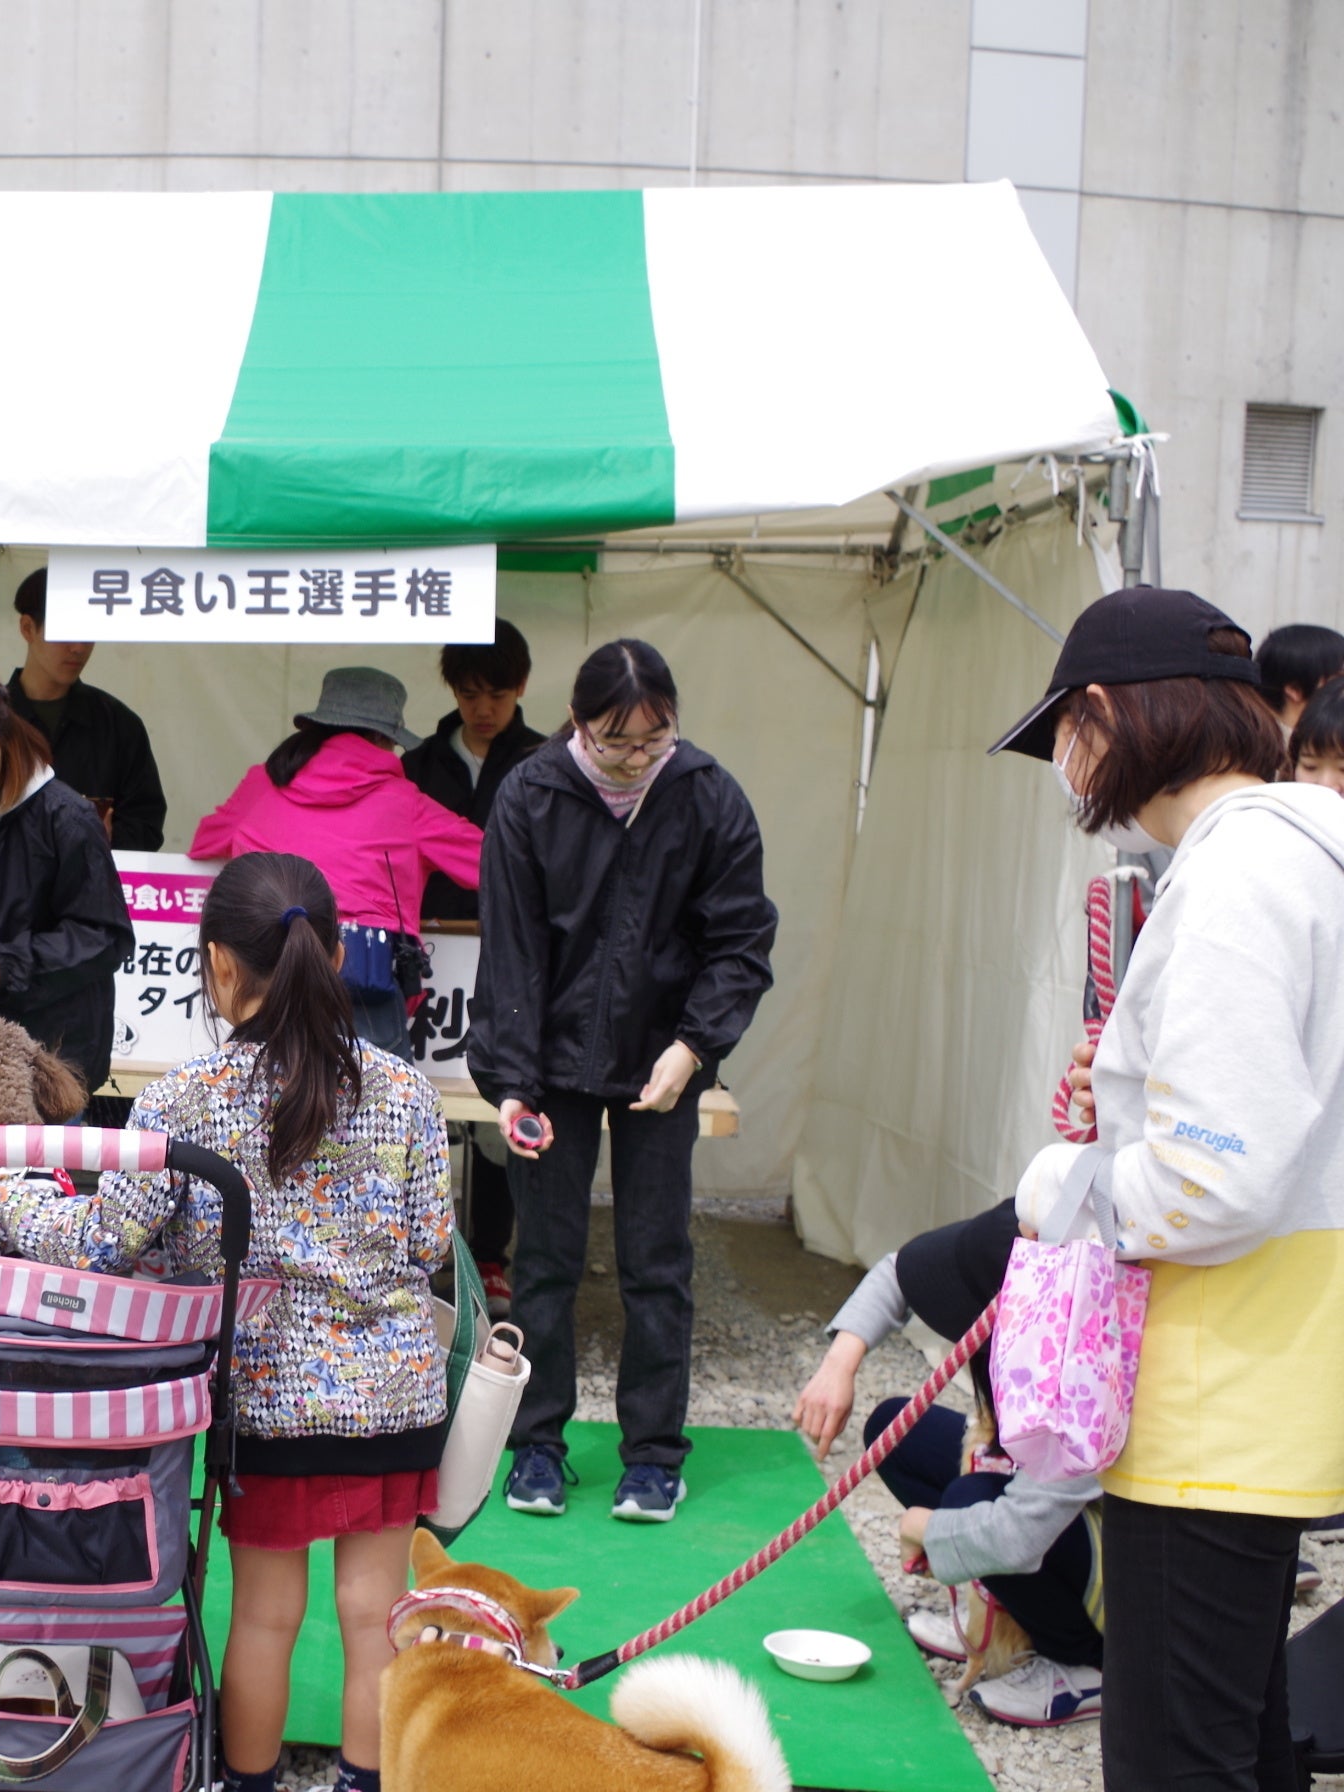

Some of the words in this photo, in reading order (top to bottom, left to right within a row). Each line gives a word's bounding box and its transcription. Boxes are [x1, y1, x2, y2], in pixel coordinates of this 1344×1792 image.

[88, 567, 453, 617] 早食い王選手権
[123, 942, 202, 976] 在の
[138, 987, 219, 1019] タイ
[410, 988, 469, 1062] 秒
[1175, 1121, 1246, 1155] perugia.
[47, 1294, 80, 1309] Richell
